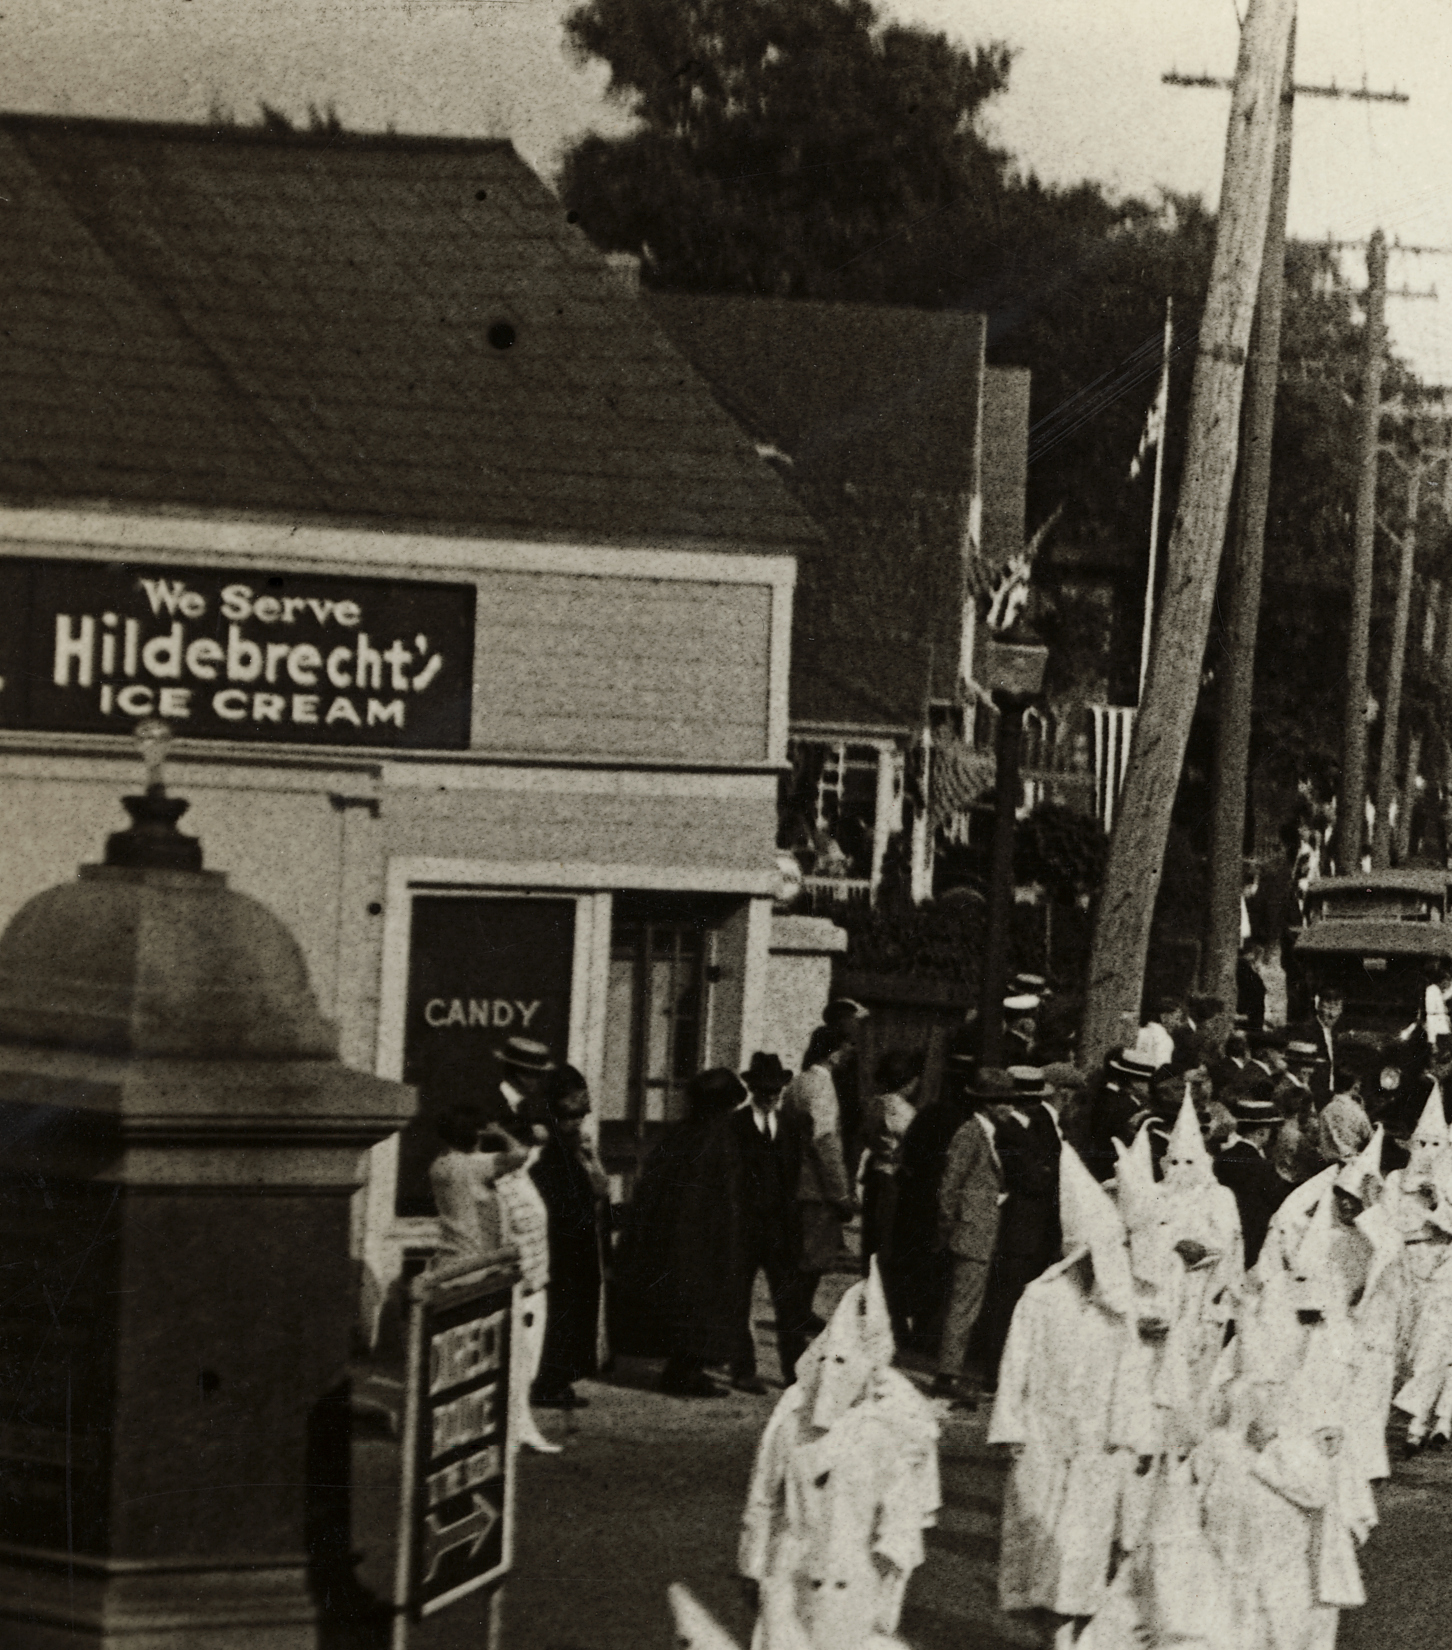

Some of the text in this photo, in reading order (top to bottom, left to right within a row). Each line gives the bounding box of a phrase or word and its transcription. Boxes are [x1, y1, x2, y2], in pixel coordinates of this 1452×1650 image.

[138, 577, 362, 627] We Serve
[53, 611, 443, 692] Hildebrecht's
[100, 684, 406, 728] ICE CREAM
[425, 998, 540, 1030] CANDY
